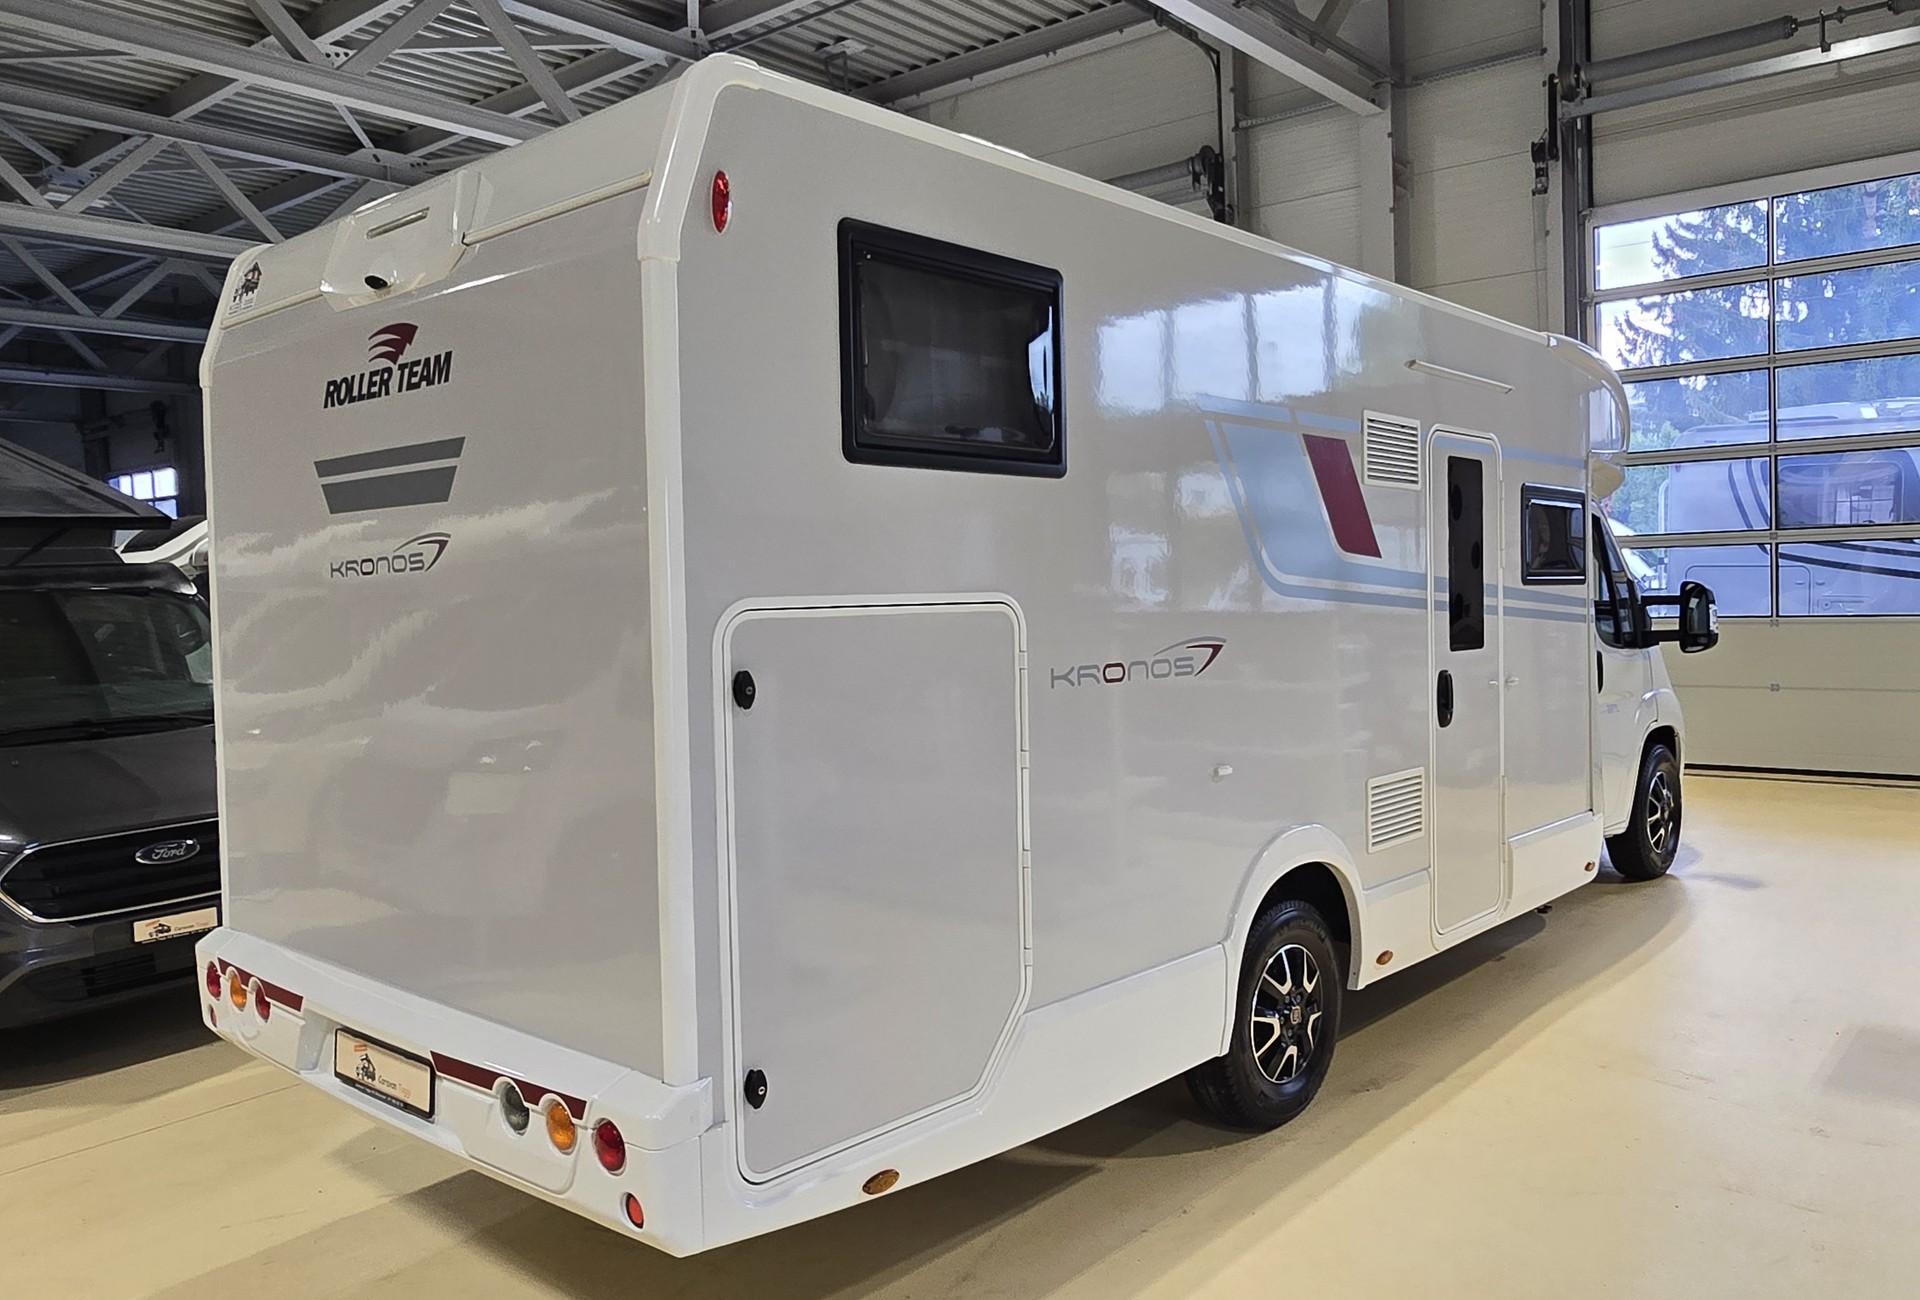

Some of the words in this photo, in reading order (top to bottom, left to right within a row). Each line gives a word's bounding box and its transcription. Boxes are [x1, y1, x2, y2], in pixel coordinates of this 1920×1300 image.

[323, 366, 393, 409] ROLLER
[397, 350, 453, 393] TEAM
[152, 843, 187, 860] Ford
